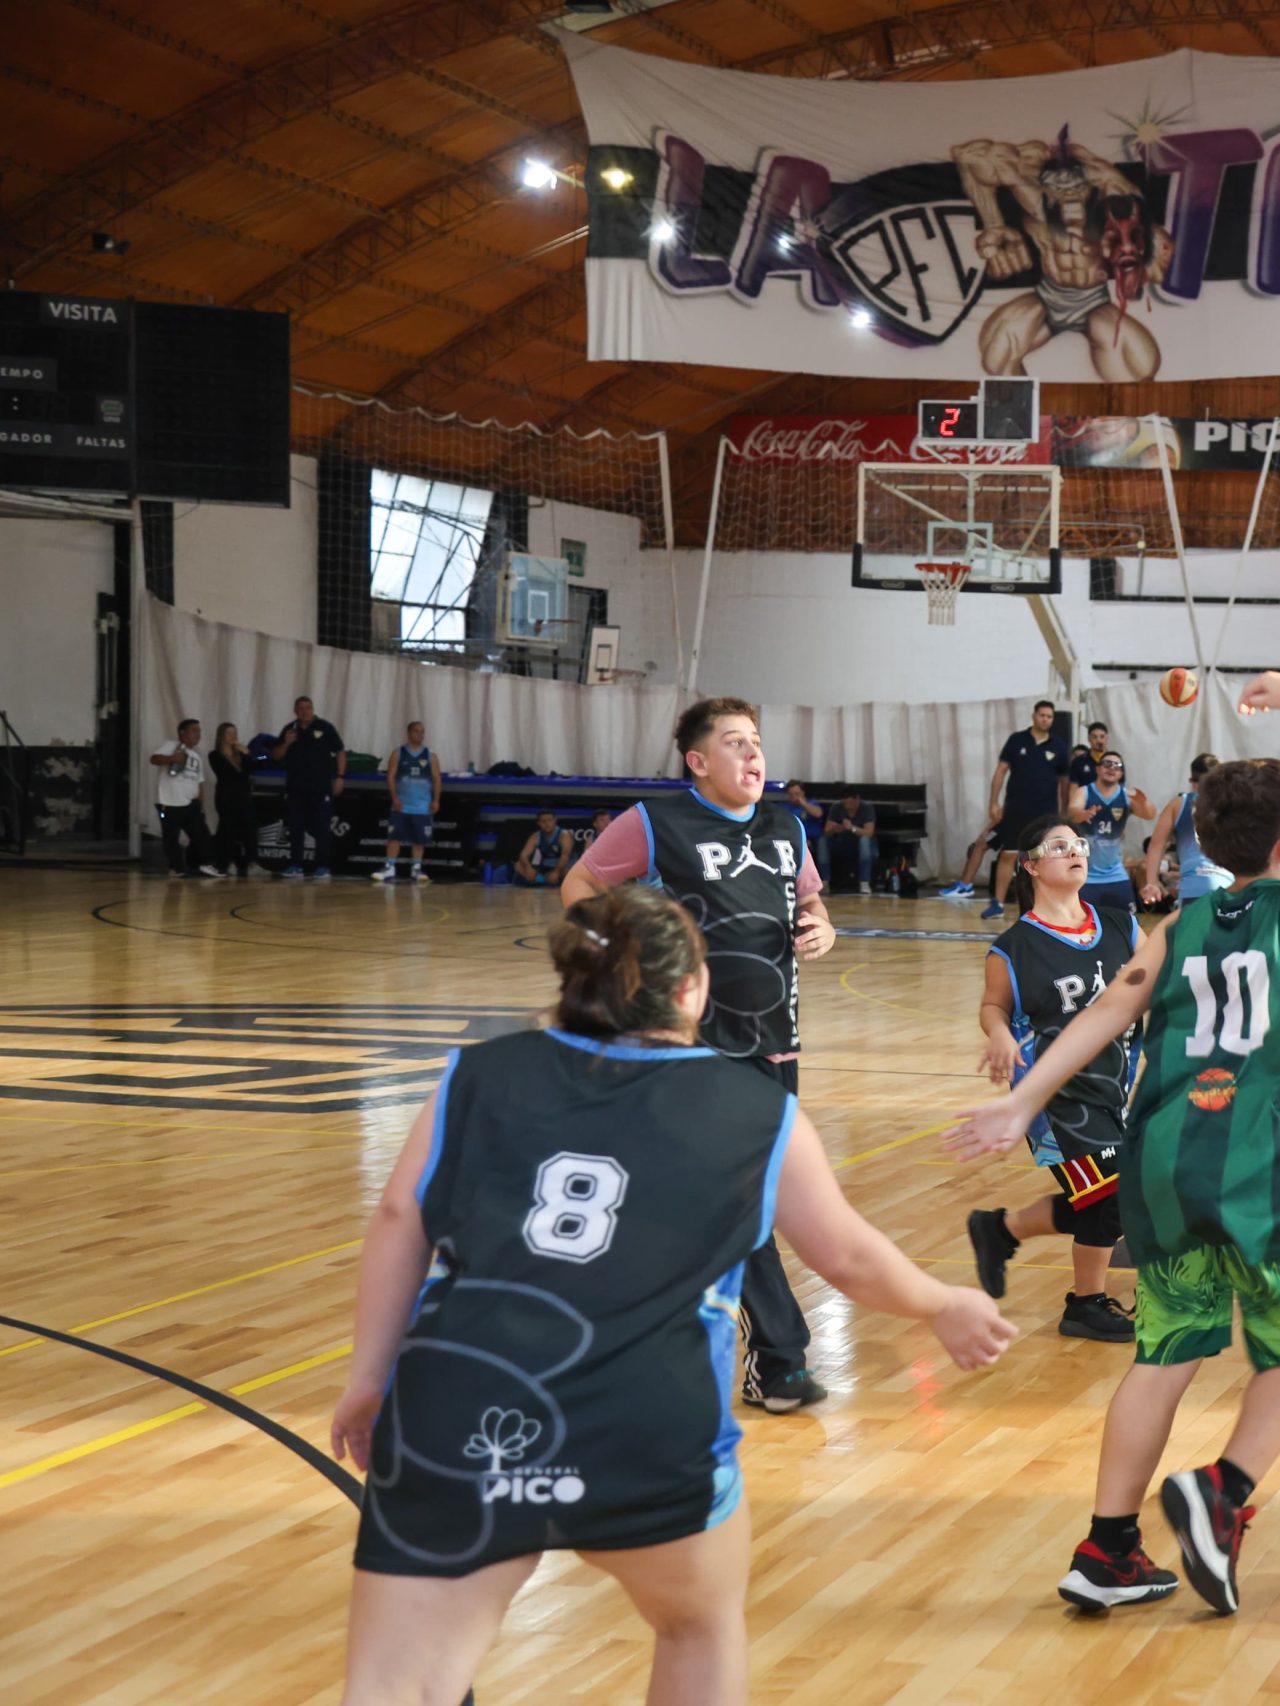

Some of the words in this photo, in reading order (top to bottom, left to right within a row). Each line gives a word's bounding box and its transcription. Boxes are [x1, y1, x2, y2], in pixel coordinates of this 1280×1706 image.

[655, 130, 841, 303] LA
[49, 302, 117, 323] VISITA
[940, 408, 960, 436] 2
[76, 436, 126, 449] FALTAS
[1098, 821, 1112, 835] 34
[1181, 949, 1271, 1058] 10
[521, 1150, 629, 1265] 8
[513, 1466, 580, 1475] GENERAL
[482, 1475, 586, 1504] PICO
